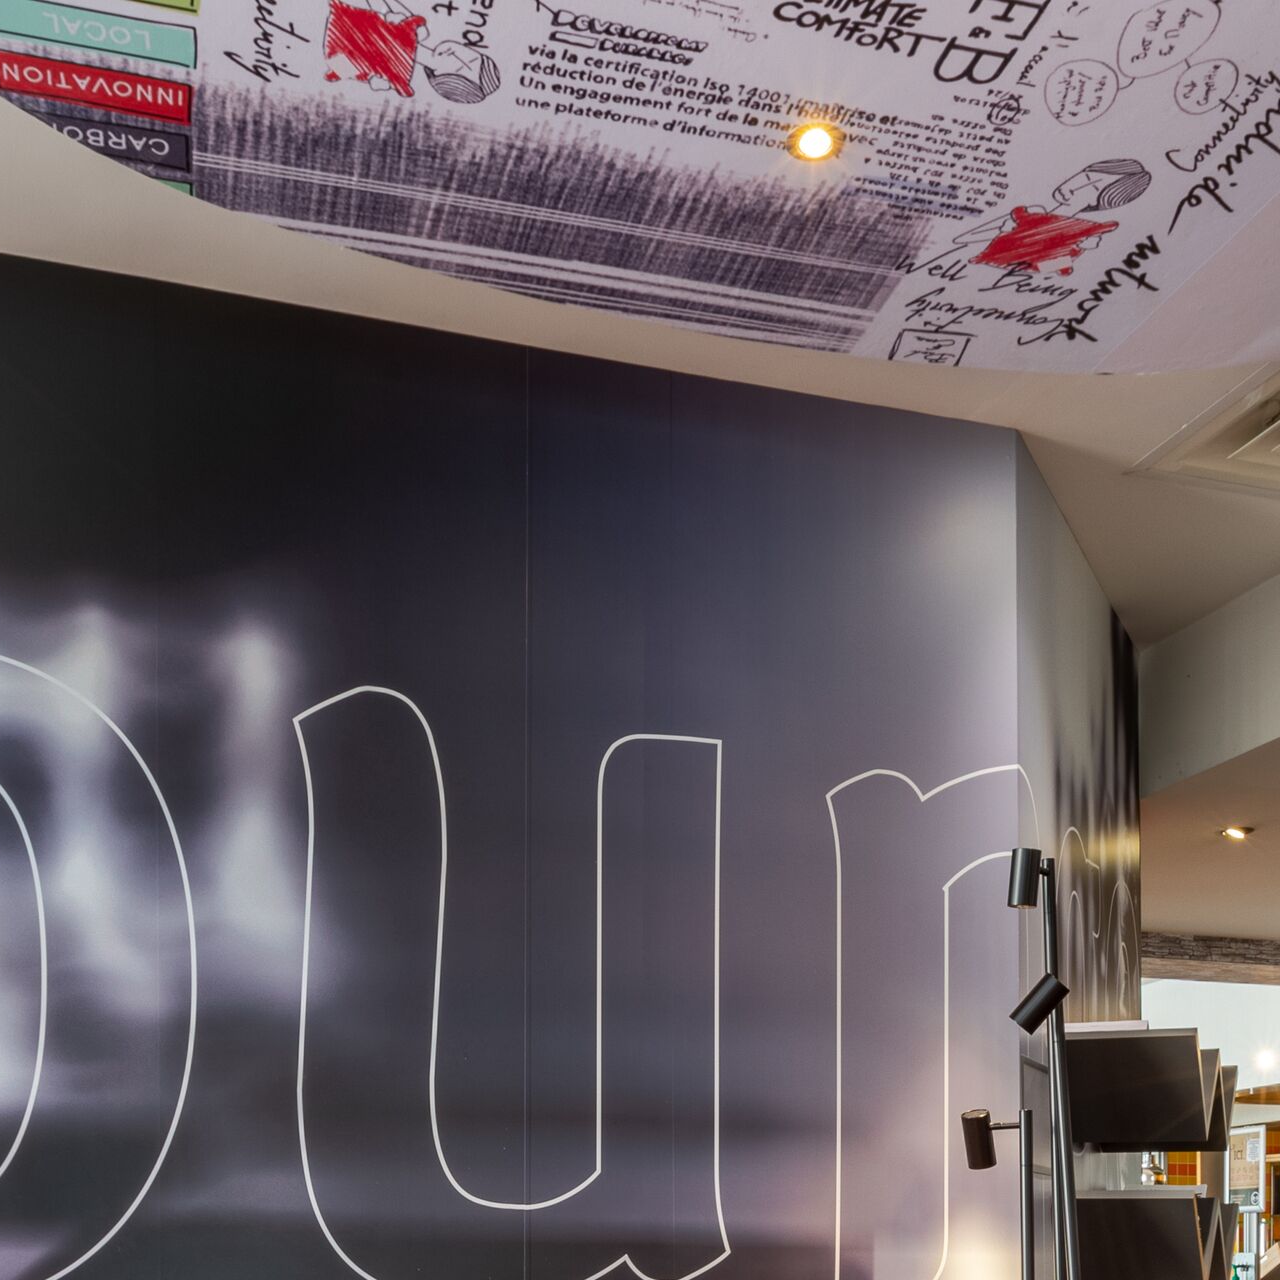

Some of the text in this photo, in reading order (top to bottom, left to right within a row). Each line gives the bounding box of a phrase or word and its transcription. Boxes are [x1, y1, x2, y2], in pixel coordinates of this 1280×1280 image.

[42, 11, 152, 51] LOCAL
[773, 1, 947, 57] COMFORT
[1, 62, 184, 107] INNOVATION
[528, 43, 556, 60] via
[562, 49, 578, 64] la
[584, 55, 698, 87] certification
[519, 75, 546, 91] Un
[551, 82, 673, 113] engagement
[677, 101, 712, 118] fort
[716, 109, 739, 123] de
[743, 112, 759, 126] la
[522, 60, 616, 86] réduction
[622, 76, 647, 92] de
[737, 97, 782, 116] dans
[515, 96, 551, 110] une
[554, 101, 658, 129] plateforme
[895, 243, 971, 282] Well
